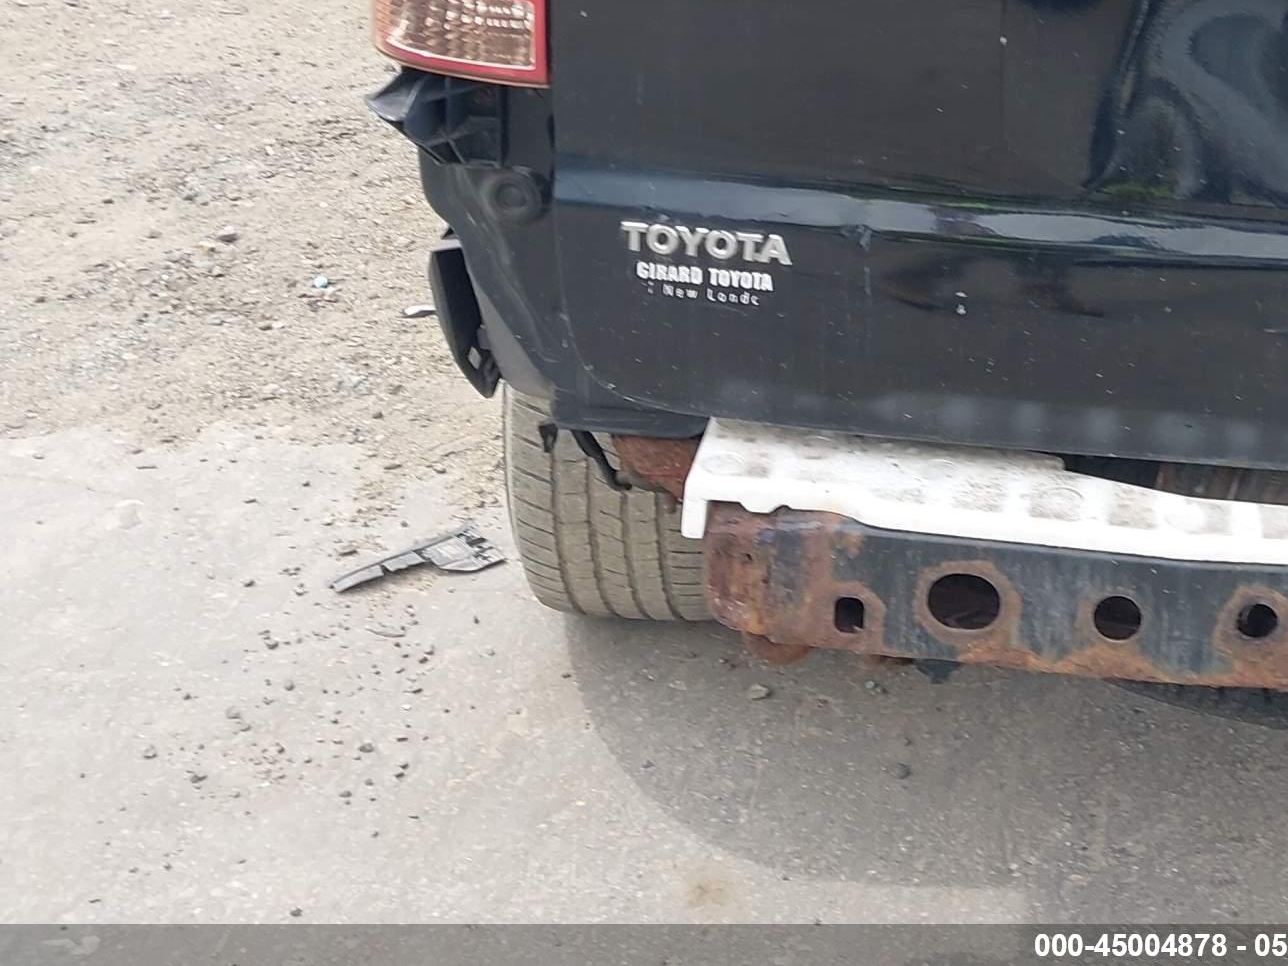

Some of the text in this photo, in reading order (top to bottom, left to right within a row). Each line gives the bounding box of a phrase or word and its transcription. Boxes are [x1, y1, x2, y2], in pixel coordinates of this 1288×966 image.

[620, 221, 793, 266] TOYOTA
[636, 260, 774, 292] GIRARD TOYOTA
[662, 283, 698, 299] New
